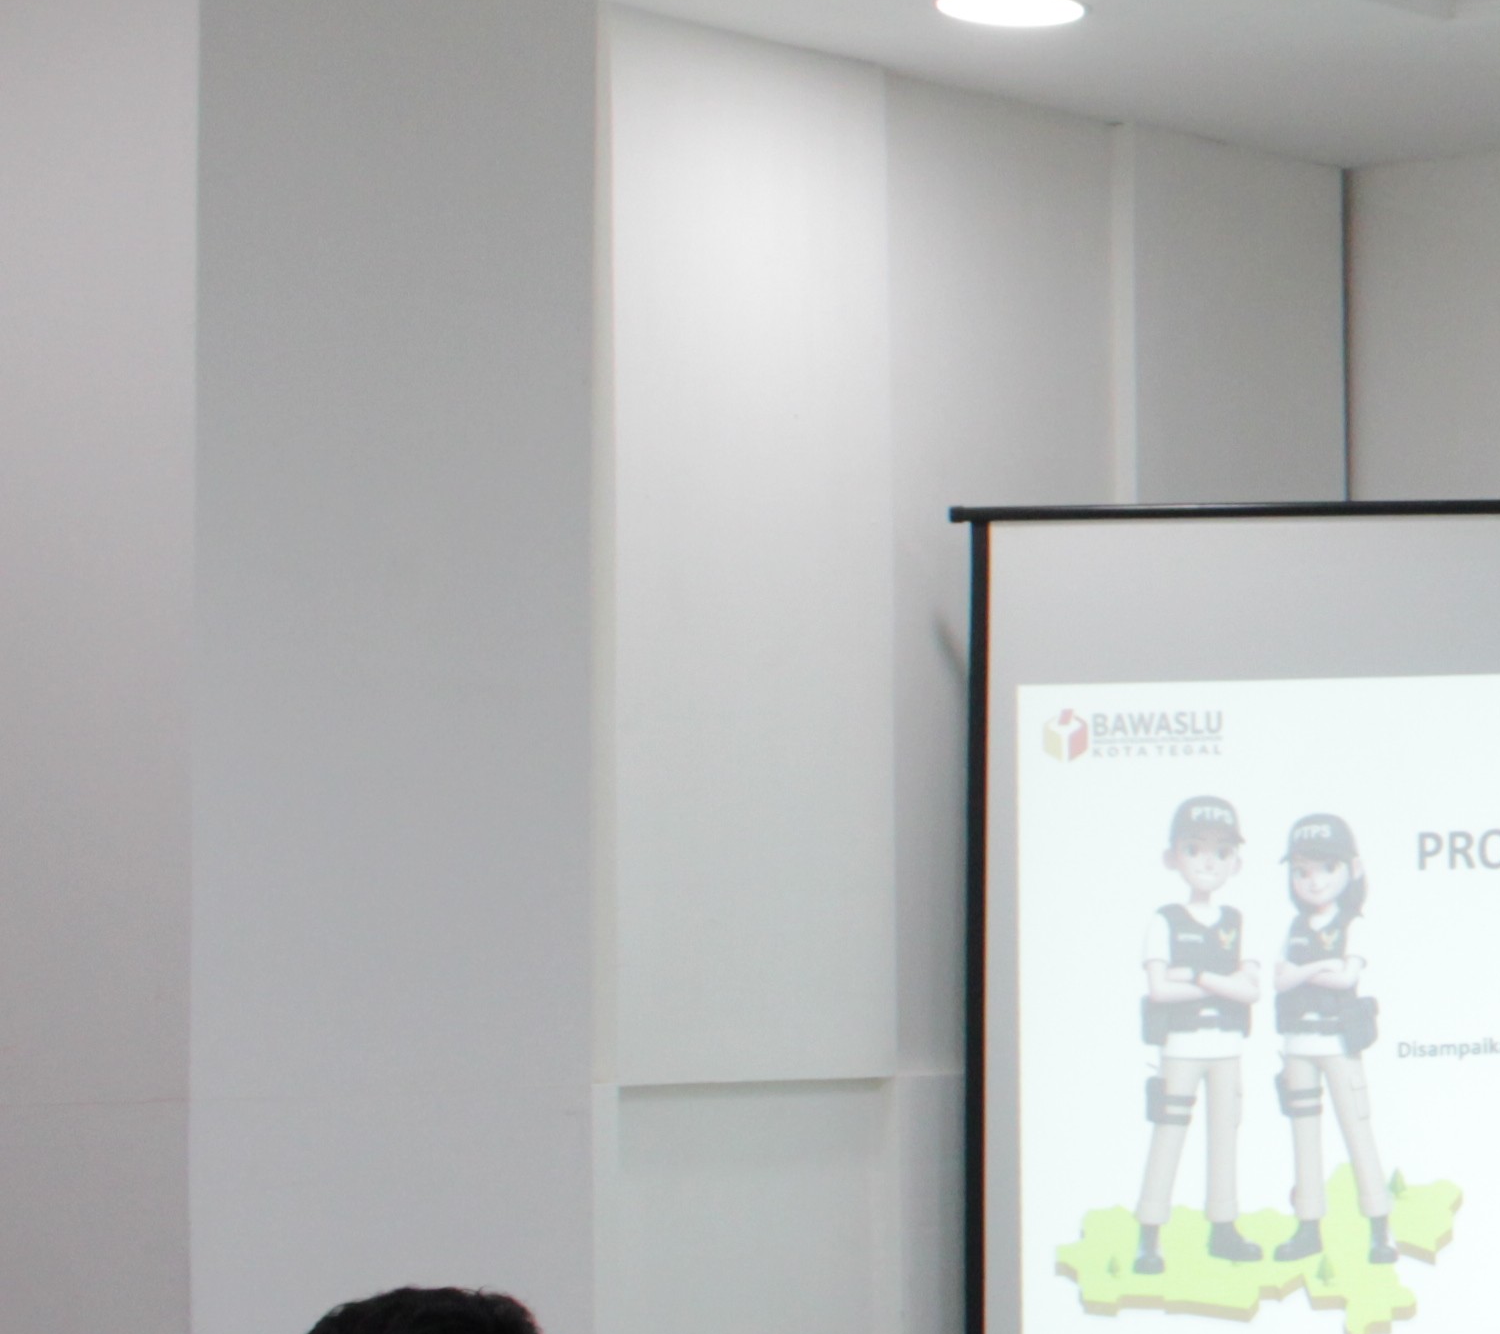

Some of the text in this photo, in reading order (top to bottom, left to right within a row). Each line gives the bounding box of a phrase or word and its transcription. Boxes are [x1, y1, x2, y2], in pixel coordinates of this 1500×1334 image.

[1091, 710, 1223, 737] BAWASLU
[1090, 742, 1222, 759] KOTA TEGAL
[1191, 806, 1234, 825] PTPS
